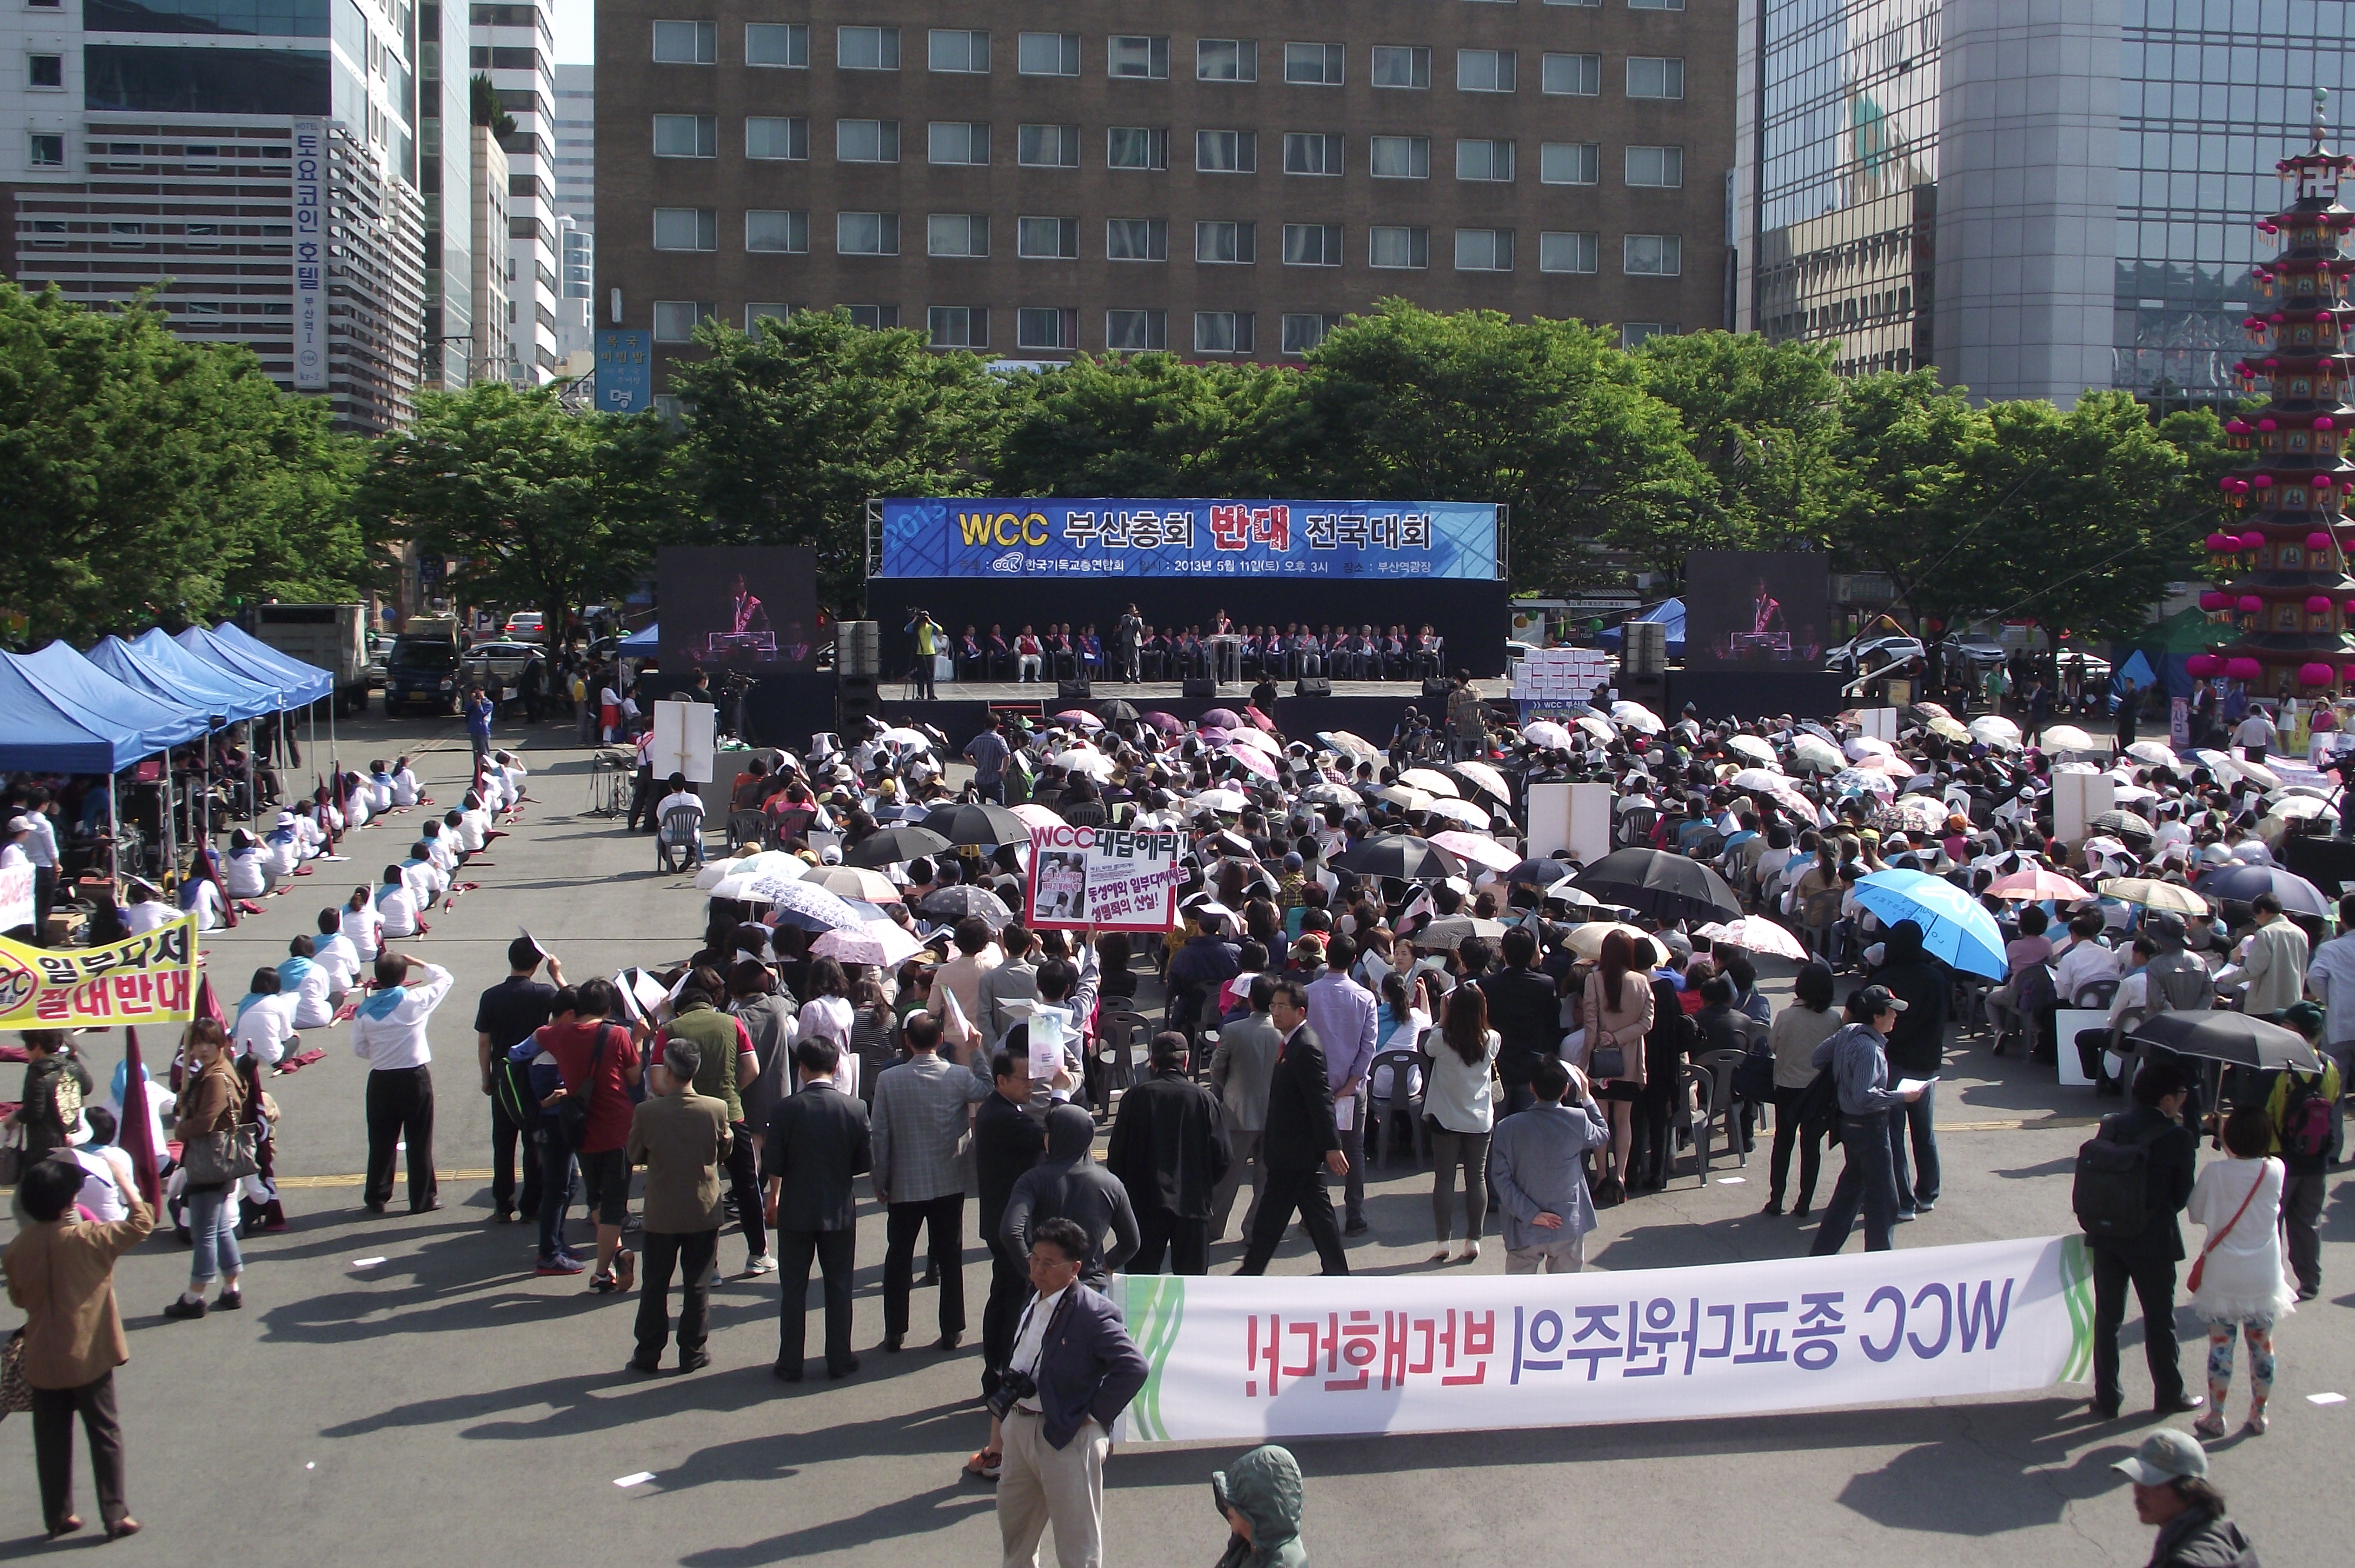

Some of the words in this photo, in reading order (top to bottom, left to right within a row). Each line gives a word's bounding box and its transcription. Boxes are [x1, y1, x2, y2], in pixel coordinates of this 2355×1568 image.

[297, 135, 318, 233] 토요코인
[298, 241, 319, 290] 호텔
[958, 513, 1049, 546] WCC
[1064, 511, 1195, 549] 부산총회
[1210, 504, 1290, 552] 반대
[1304, 514, 1431, 550] 전국대회
[1025, 559, 1124, 572] 한국기독교총연합회
[1175, 560, 1212, 572] 2013년
[1216, 560, 1235, 572] 5월
[1239, 560, 1279, 572] 11일(토)
[1284, 560, 1306, 572] 오후
[1311, 561, 1329, 573] 3시
[1378, 561, 1432, 573] 부산역광장
[477, 611, 493, 630] P
[1031, 826, 1094, 848] WCC
[1095, 829, 1188, 861] 대답해라!
[1088, 881, 1128, 903] 동성애와
[37, 969, 190, 1020] 절대반대
